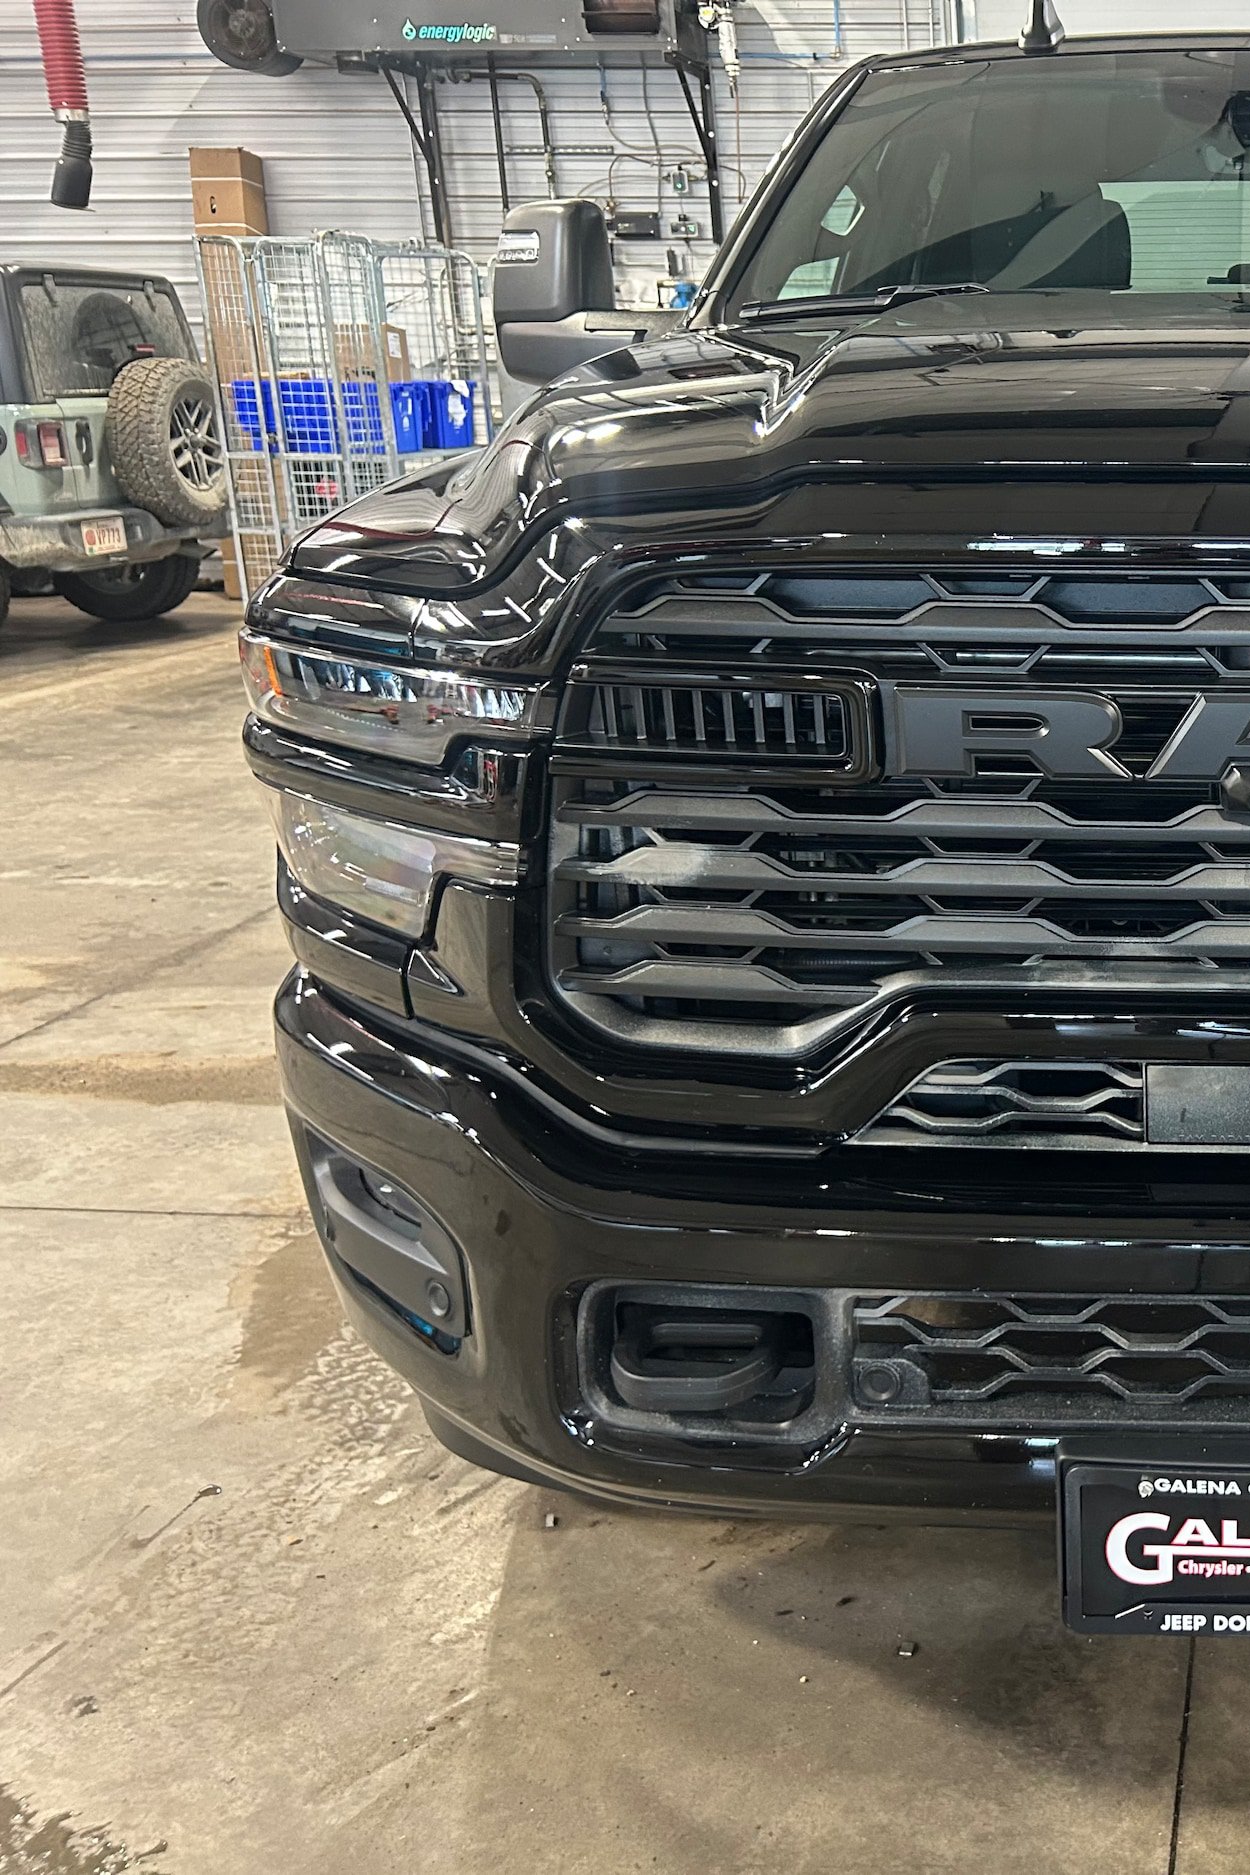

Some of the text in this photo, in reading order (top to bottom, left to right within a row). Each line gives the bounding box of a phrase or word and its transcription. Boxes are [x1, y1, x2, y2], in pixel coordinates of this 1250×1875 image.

[418, 22, 494, 43] energylogic
[1154, 1478, 1241, 1496] GALENA
[1177, 1559, 1244, 1578] Chrysler
[1160, 1614, 1207, 1632] JEEP
